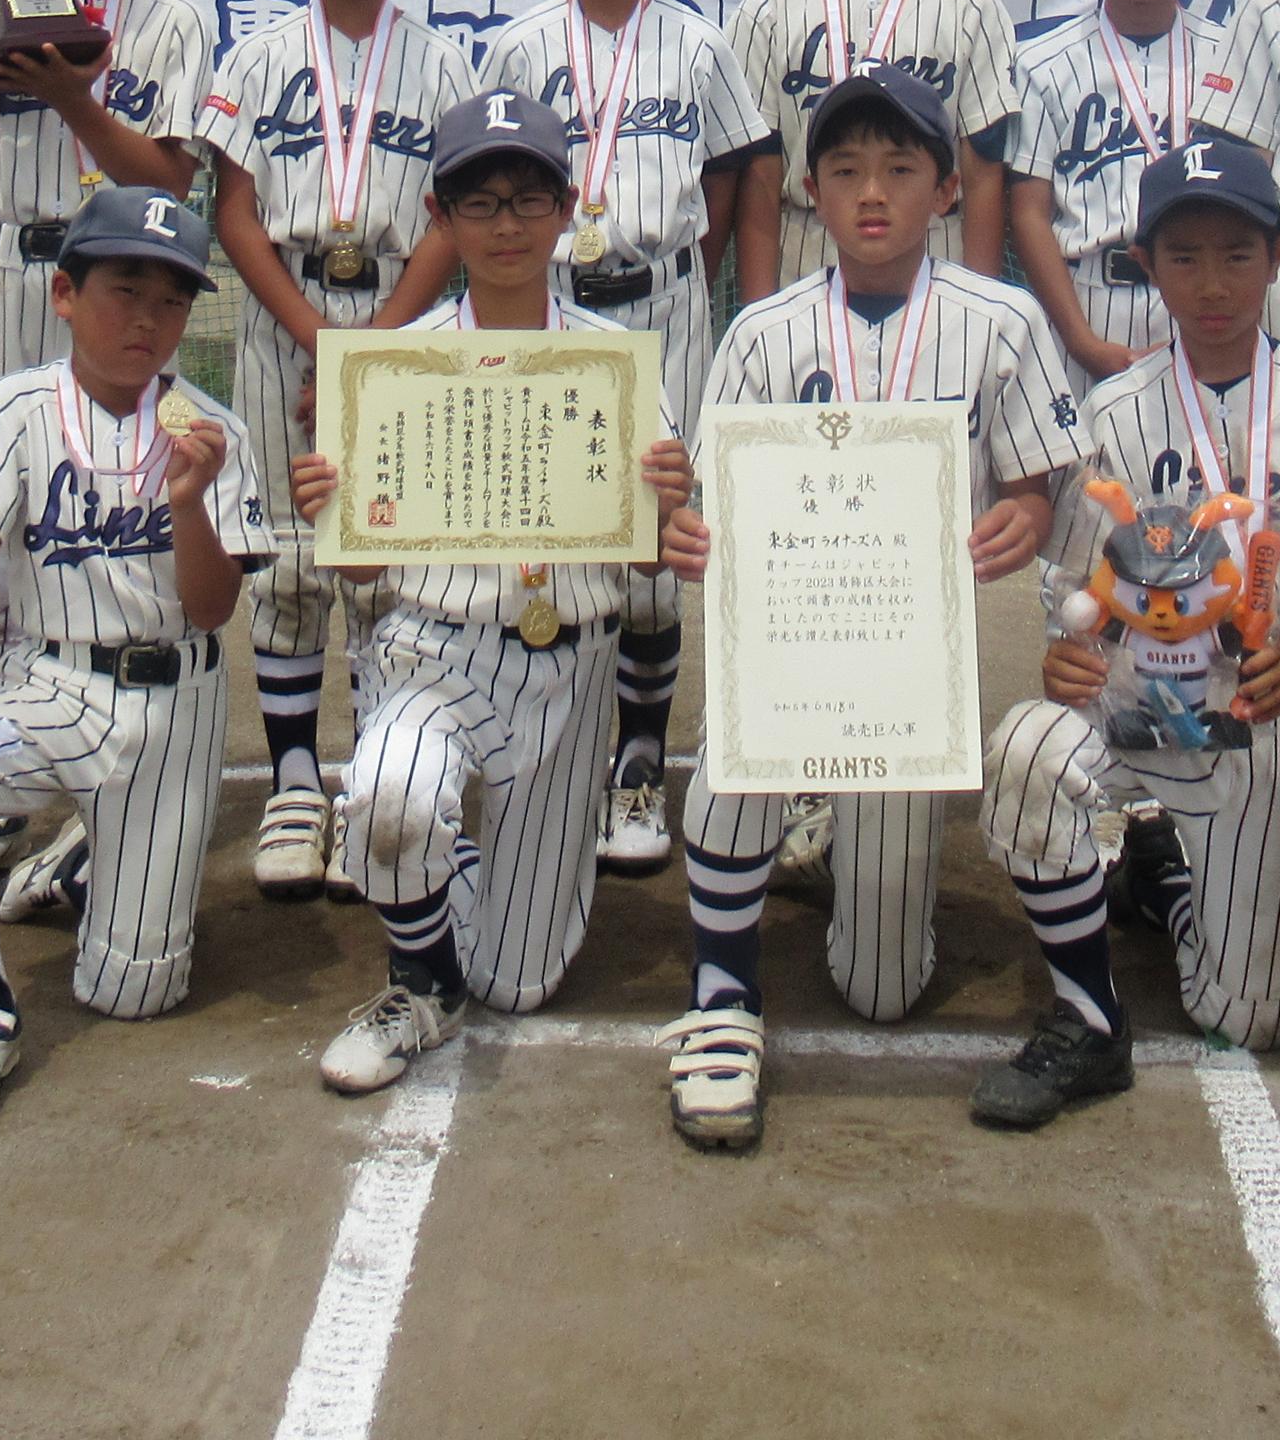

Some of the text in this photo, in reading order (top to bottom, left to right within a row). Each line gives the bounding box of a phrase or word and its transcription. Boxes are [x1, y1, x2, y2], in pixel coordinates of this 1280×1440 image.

[563, 388, 579, 421] 優勝
[586, 409, 608, 483] 表彰状
[796, 473, 877, 494] 表彰状
[23, 458, 174, 569] Line
[1252, 544, 1275, 613] GIANTS
[768, 612, 914, 625] ましたのでここにその
[1147, 652, 1197, 665] GIANTS
[841, 722, 917, 738] 読売巨人軍
[803, 756, 888, 779] GIANTS
